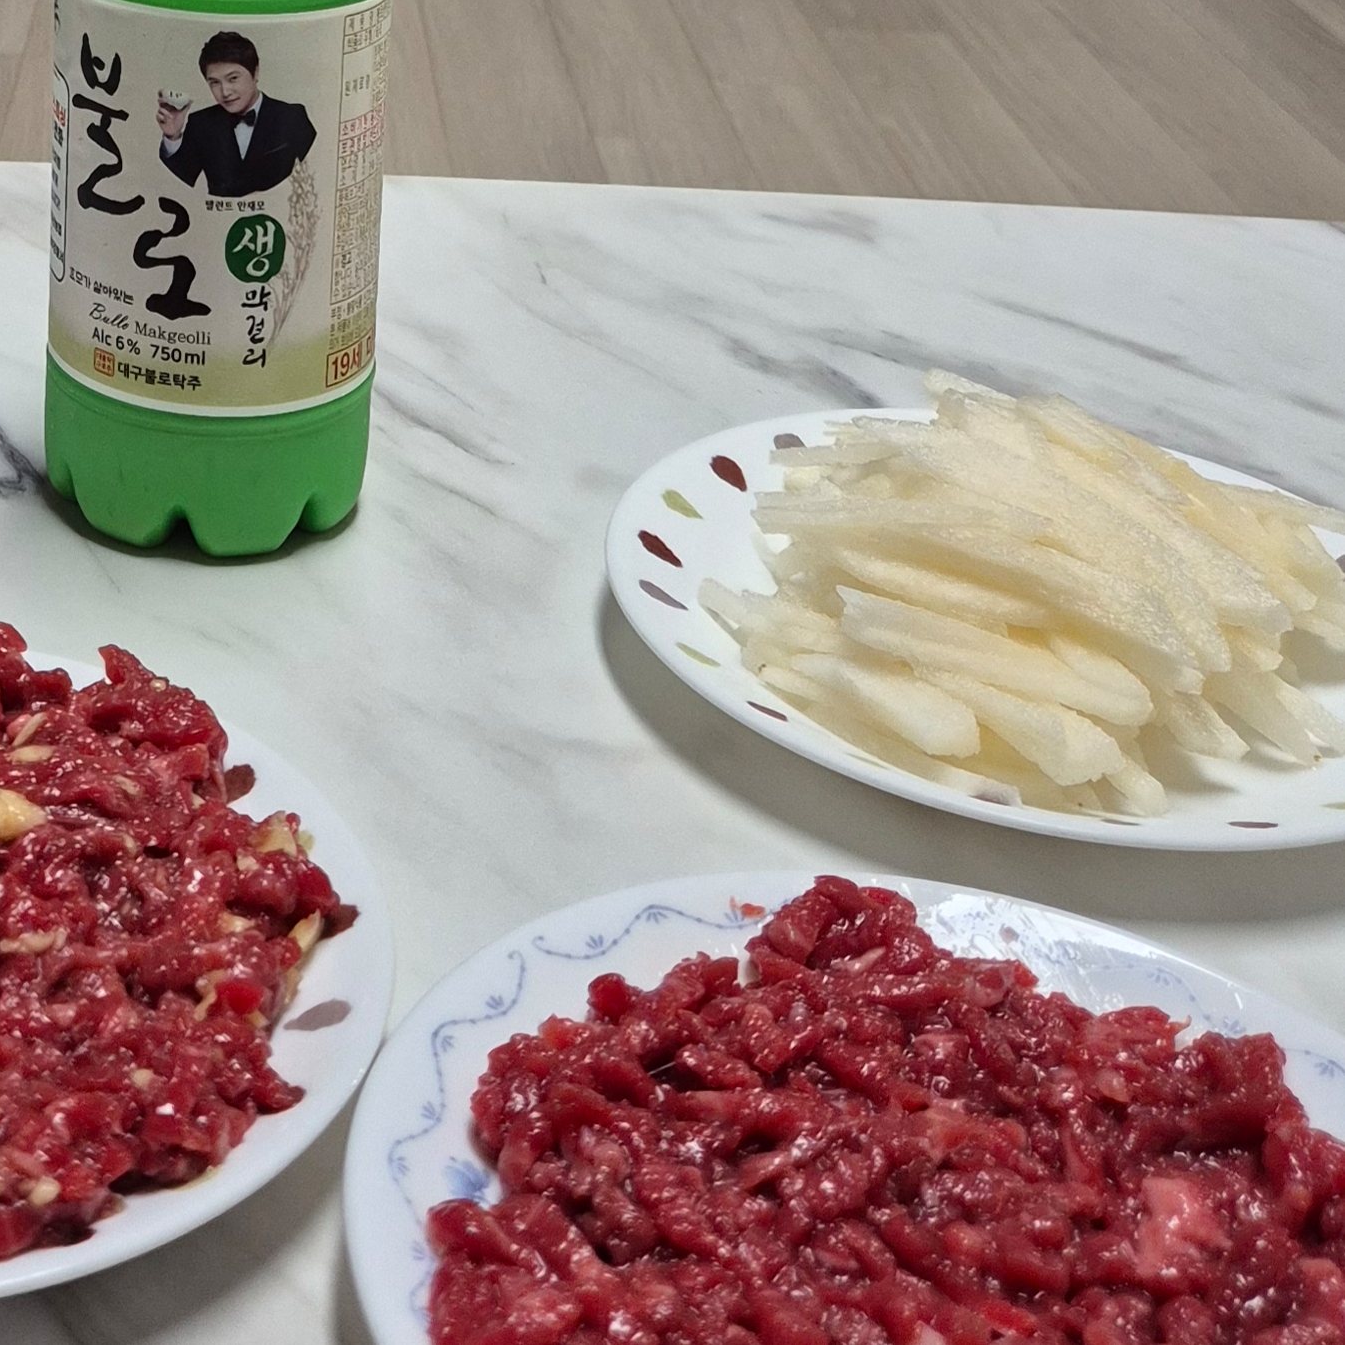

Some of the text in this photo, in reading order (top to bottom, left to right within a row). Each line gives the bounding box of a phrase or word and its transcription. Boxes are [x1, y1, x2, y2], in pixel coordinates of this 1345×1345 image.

[72, 32, 212, 321] 불로
[93, 280, 135, 306] 살아있는
[232, 220, 276, 368] 생 막걸리
[92, 327, 207, 366] Alc 6% 750ml
[134, 320, 212, 345] Makgeolli
[117, 361, 202, 392] 대구불로탁주
